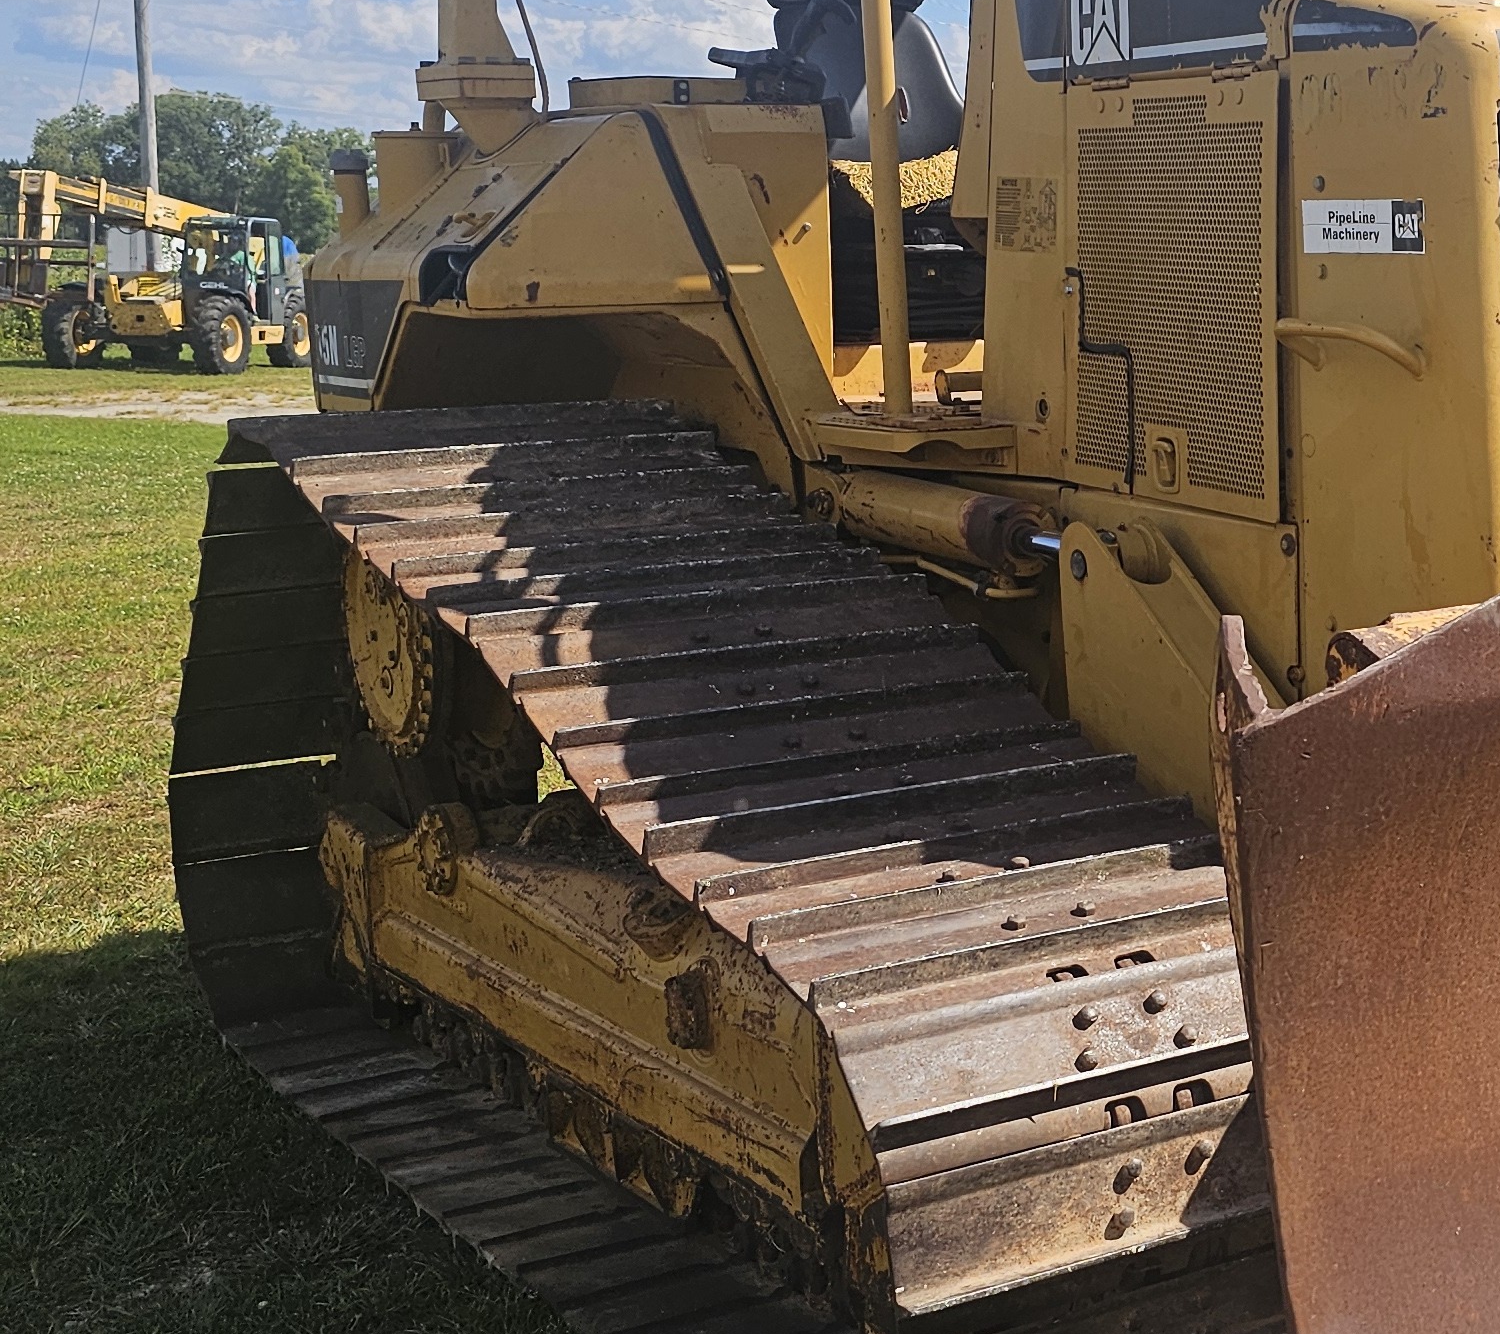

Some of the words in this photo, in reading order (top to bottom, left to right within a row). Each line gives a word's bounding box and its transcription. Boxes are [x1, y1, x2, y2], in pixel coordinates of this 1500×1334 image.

[1327, 210, 1376, 227] PipeLine
[1394, 213, 1420, 239] CAT
[1321, 227, 1381, 244] Machinery
